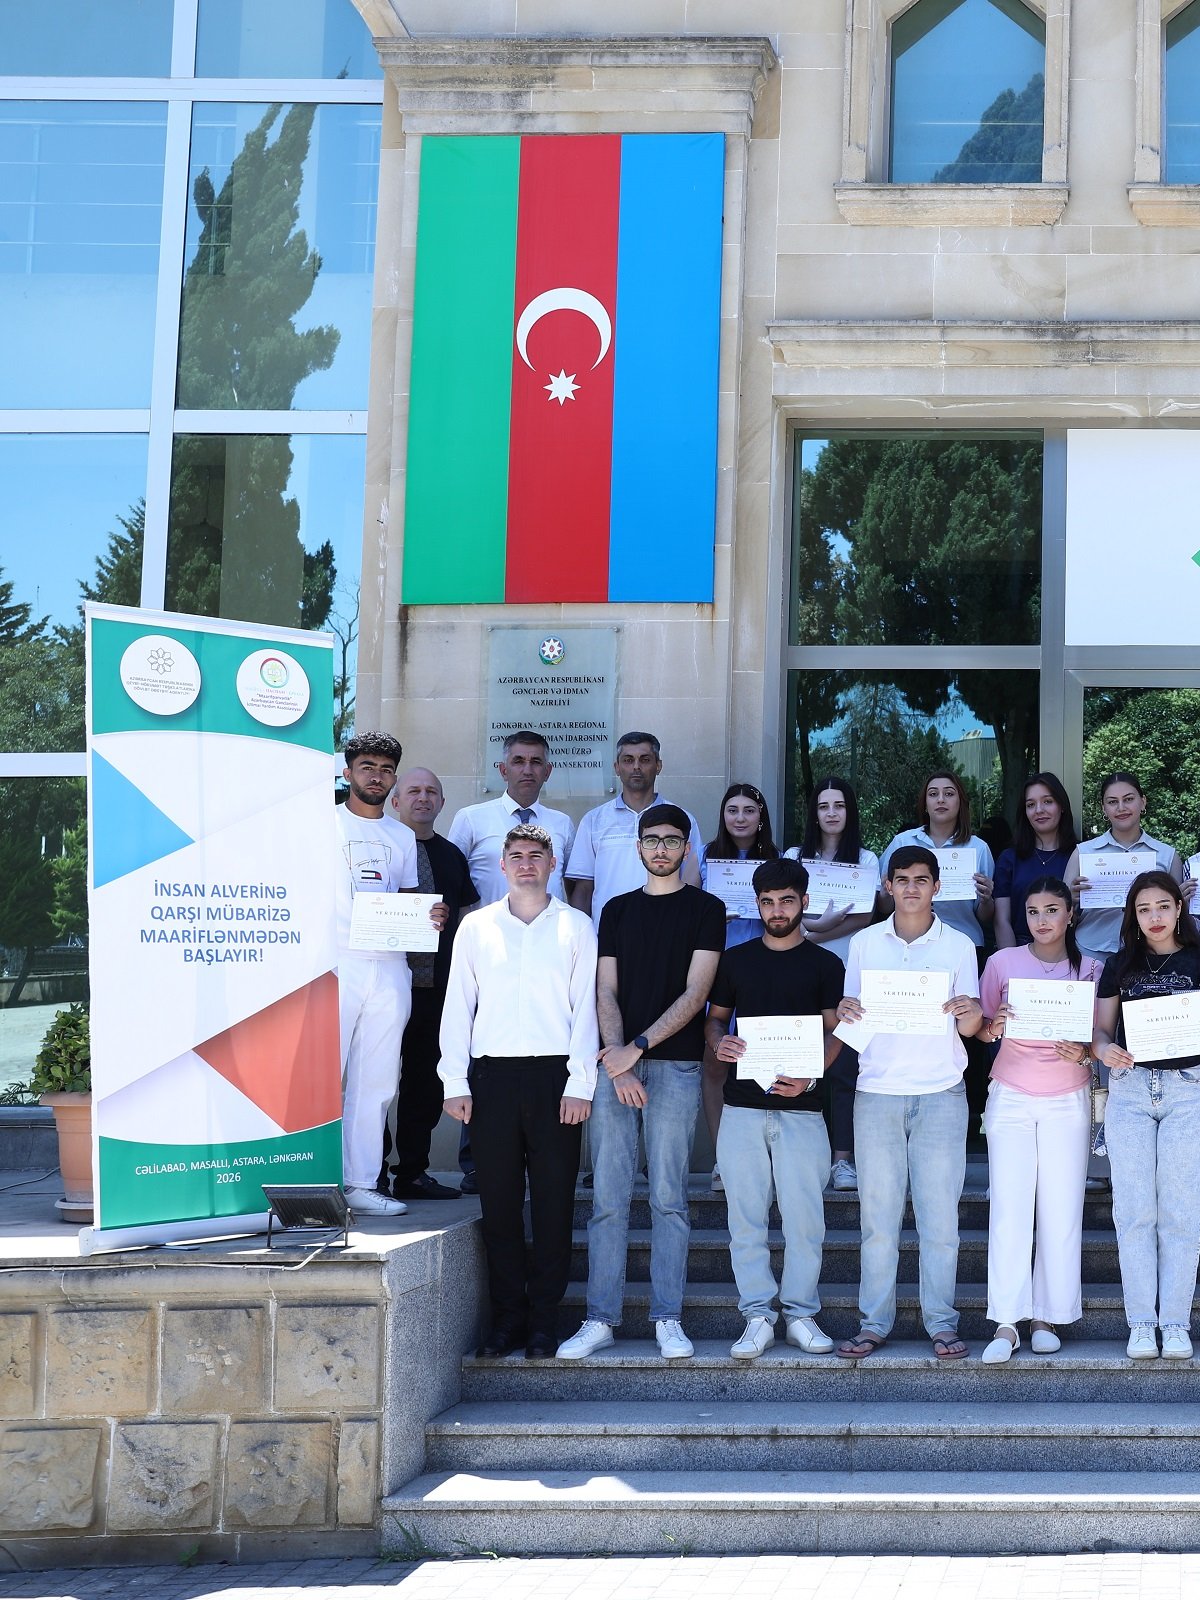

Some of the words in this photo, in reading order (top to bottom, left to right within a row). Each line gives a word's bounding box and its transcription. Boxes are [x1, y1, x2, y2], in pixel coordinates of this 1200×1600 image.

[530, 698, 570, 706] NAZİRLİYİ
[569, 721, 606, 729] REGİONAL
[154, 880, 206, 897] İNSAN
[210, 882, 287, 900] ALVERİNƏ
[150, 906, 201, 924] QARŞI
[206, 904, 291, 922] MÜBARİZƏ
[140, 926, 301, 944] MAARİFLƏNMƏDƏN
[184, 948, 264, 965] BAŞLAYIR!
[135, 1162, 188, 1176] CƏLİLABAD,
[232, 1157, 267, 1168] ASTARA,
[269, 1152, 314, 1164] LƏNKƏRAN
[216, 1172, 241, 1184] 2026
